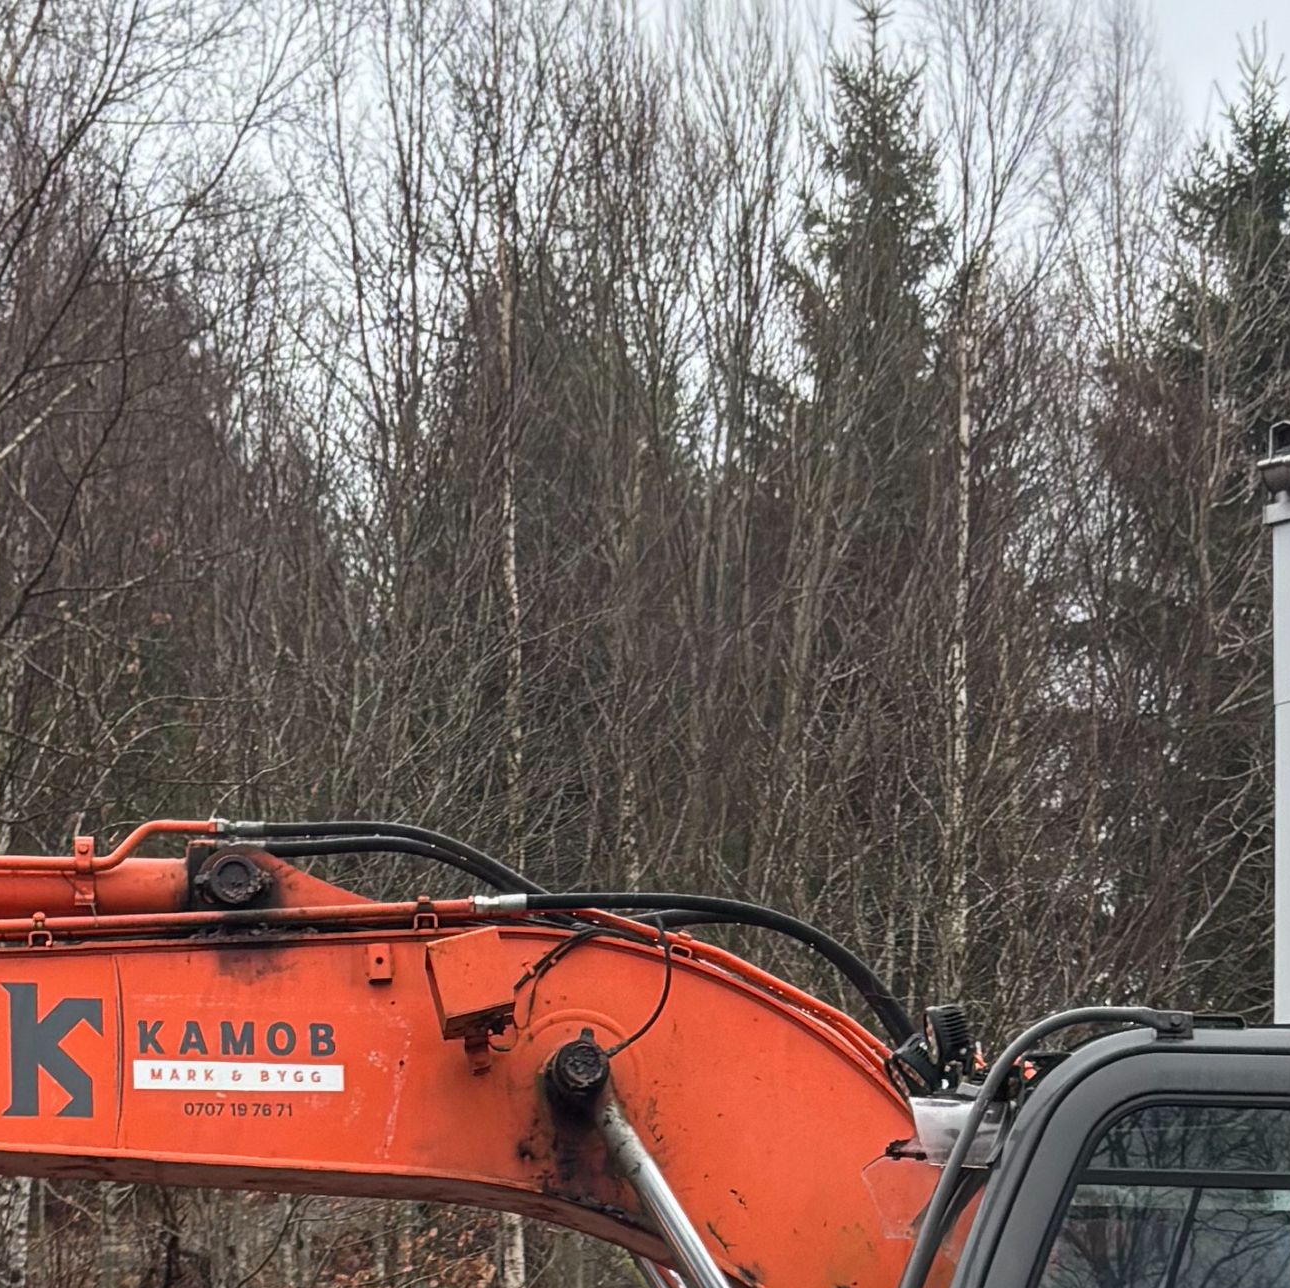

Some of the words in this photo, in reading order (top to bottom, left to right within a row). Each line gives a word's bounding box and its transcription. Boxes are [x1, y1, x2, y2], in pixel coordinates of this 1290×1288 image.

[137, 1019, 337, 1057] KAMOB
[150, 1067, 215, 1082] MARK
[231, 1069, 243, 1083] &
[260, 1070, 322, 1083] BYGG
[184, 1102, 224, 1117] 0707
[230, 1102, 248, 1117] 19
[253, 1103, 272, 1117] 76
[277, 1103, 294, 1117] 71
